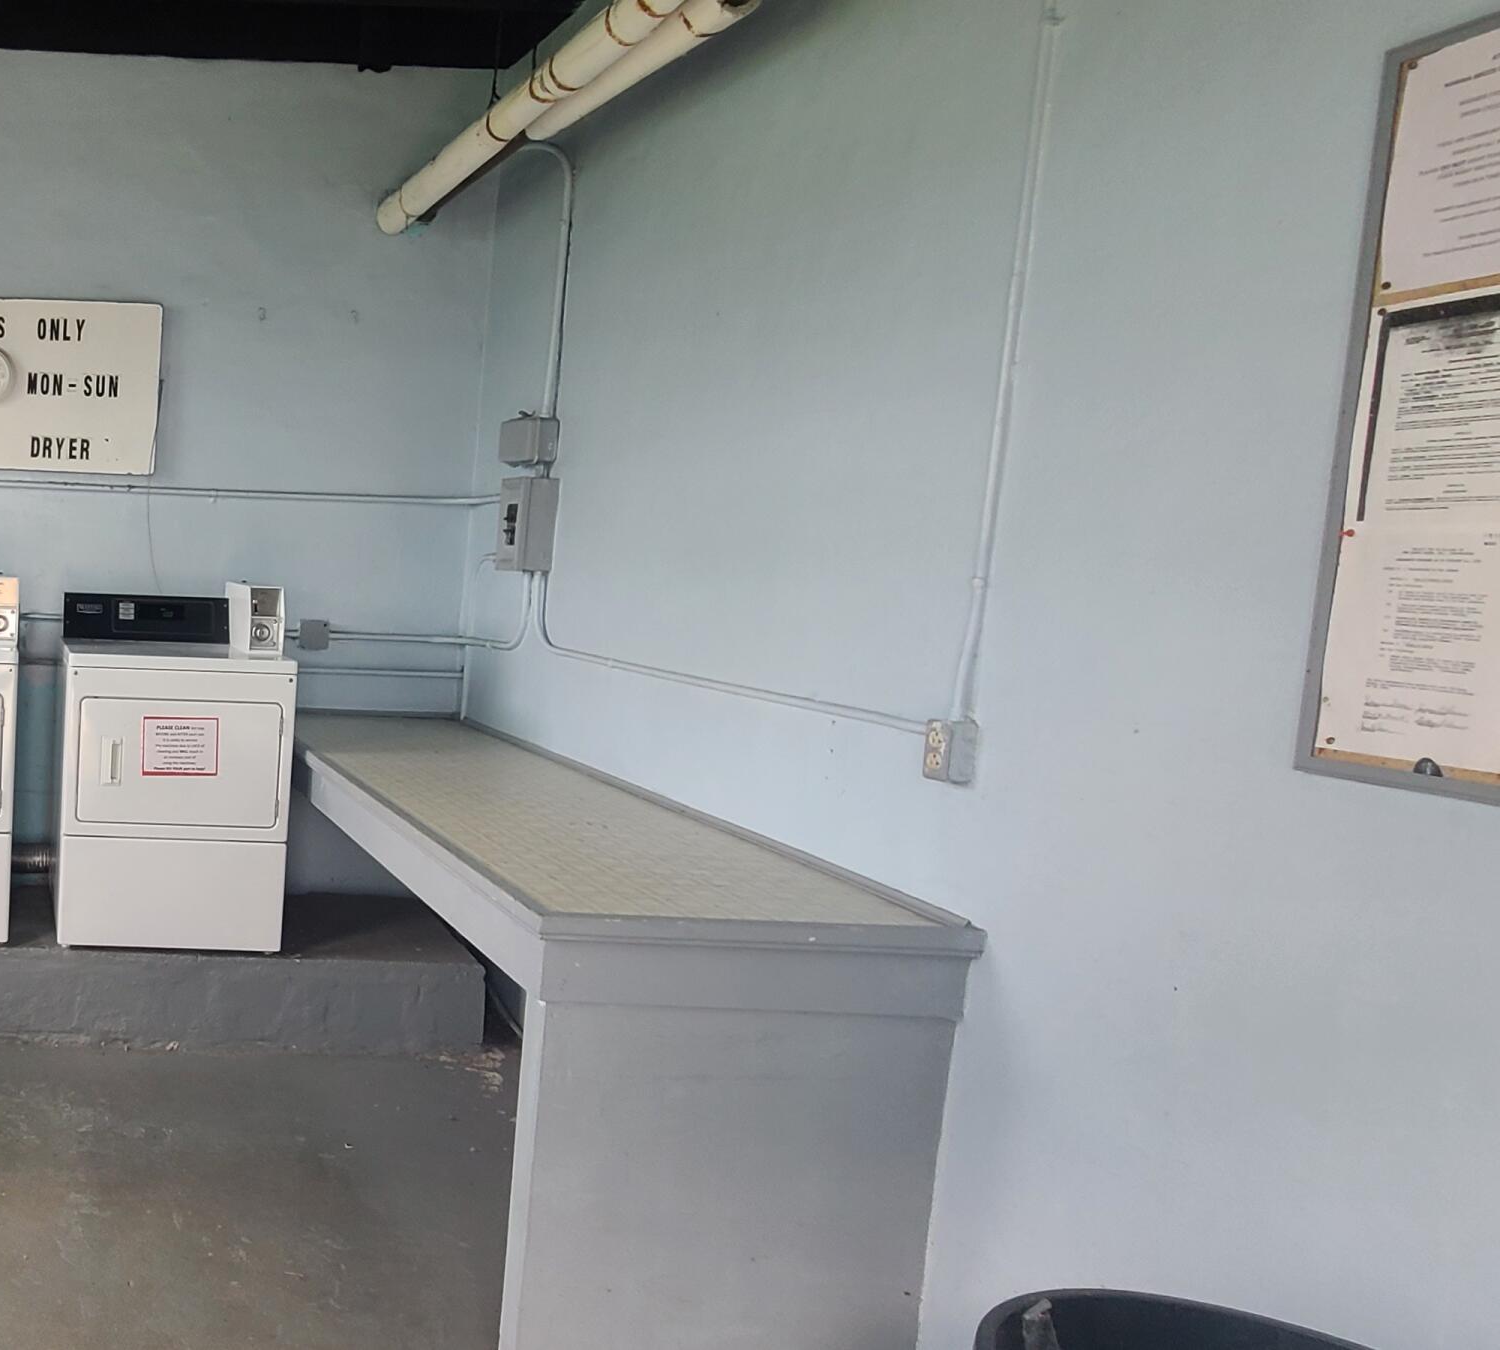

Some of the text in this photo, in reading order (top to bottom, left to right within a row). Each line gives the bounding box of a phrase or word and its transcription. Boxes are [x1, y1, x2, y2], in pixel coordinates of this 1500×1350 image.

[37, 318, 86, 342] ONLY
[26, 372, 120, 398] MON-SUN
[30, 436, 91, 461] DRYER
